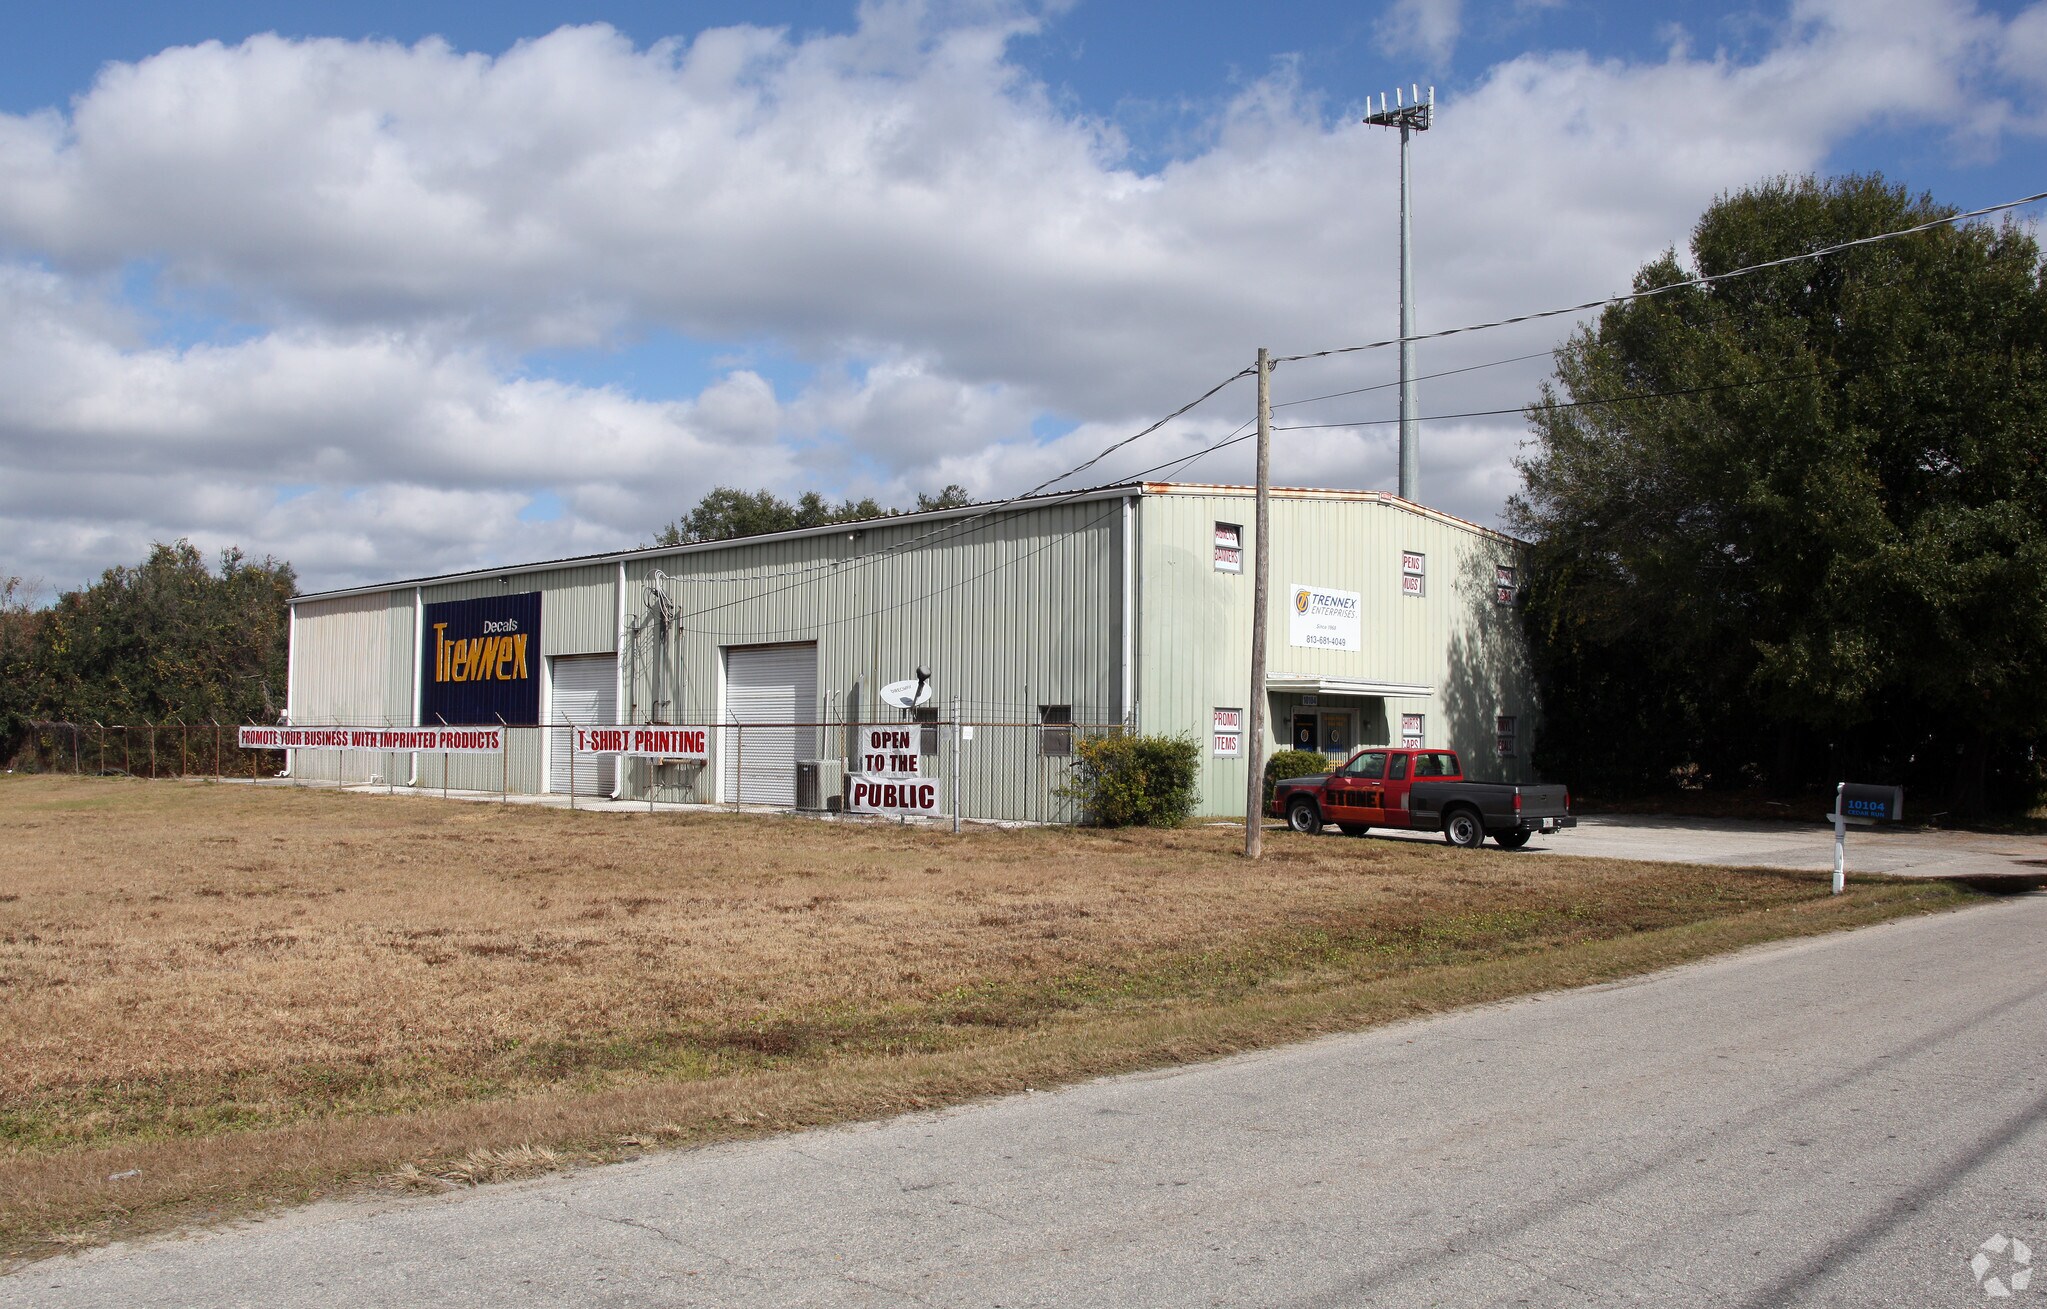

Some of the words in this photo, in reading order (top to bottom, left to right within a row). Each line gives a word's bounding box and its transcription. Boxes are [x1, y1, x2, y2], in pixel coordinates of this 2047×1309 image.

[1403, 555, 1420, 570] PENS
[1312, 593, 1358, 609] TRENNEX
[483, 618, 518, 634] Decals
[1214, 712, 1238, 727] PROMO
[241, 730, 278, 745] PROMOTE
[280, 730, 302, 746] YOUR
[304, 730, 348, 746] BUSINESS
[351, 731, 377, 748] WITH
[380, 731, 437, 749] IMPRINTED
[440, 731, 499, 749] PRODUCTS
[578, 730, 630, 751] T-SHIRT
[635, 730, 705, 753] PRINTING
[871, 731, 910, 749] OPEN
[1214, 736, 1237, 751] ITEMS
[865, 754, 885, 772] TO
[889, 754, 918, 772] THE
[854, 783, 935, 809] PUBLIC
[1848, 800, 1885, 811] 10104
